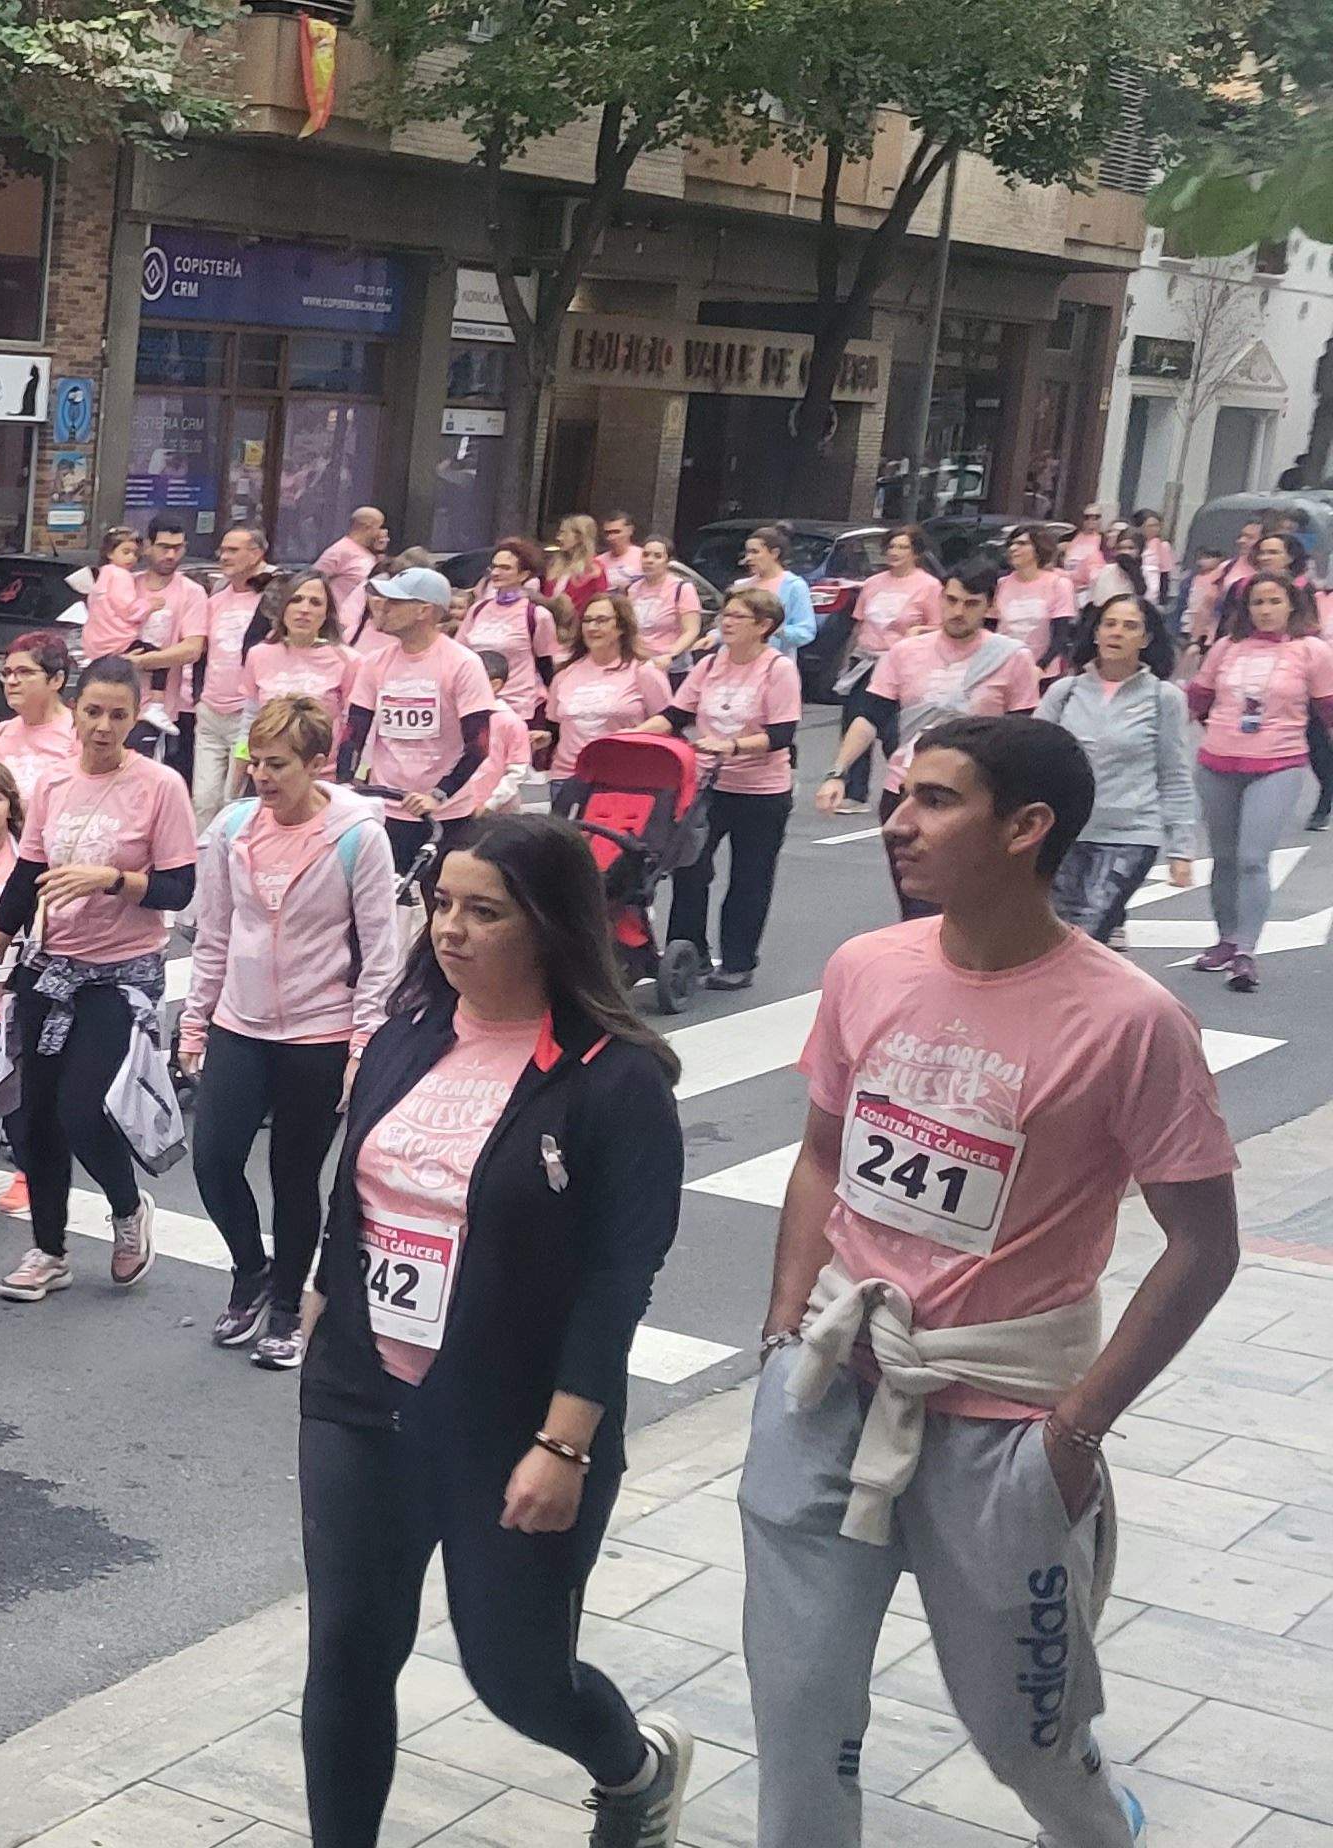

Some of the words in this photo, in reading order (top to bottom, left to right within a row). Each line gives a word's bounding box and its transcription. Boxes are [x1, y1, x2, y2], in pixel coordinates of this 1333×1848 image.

[173, 256, 242, 278] COPISTERÍA
[171, 280, 199, 297] CRM
[685, 338, 757, 383] VALLE
[762, 345, 794, 388] DE
[380, 708, 434, 727] 3109
[860, 1105, 913, 1140] CONTRA
[916, 1132, 932, 1147] EL
[934, 1137, 1002, 1170] CÁNCER
[906, 1112, 949, 1138] HUESCA
[856, 1134, 969, 1215] 241
[389, 1240, 444, 1262] CÁNCER
[1016, 1563, 1070, 1749] adidas
